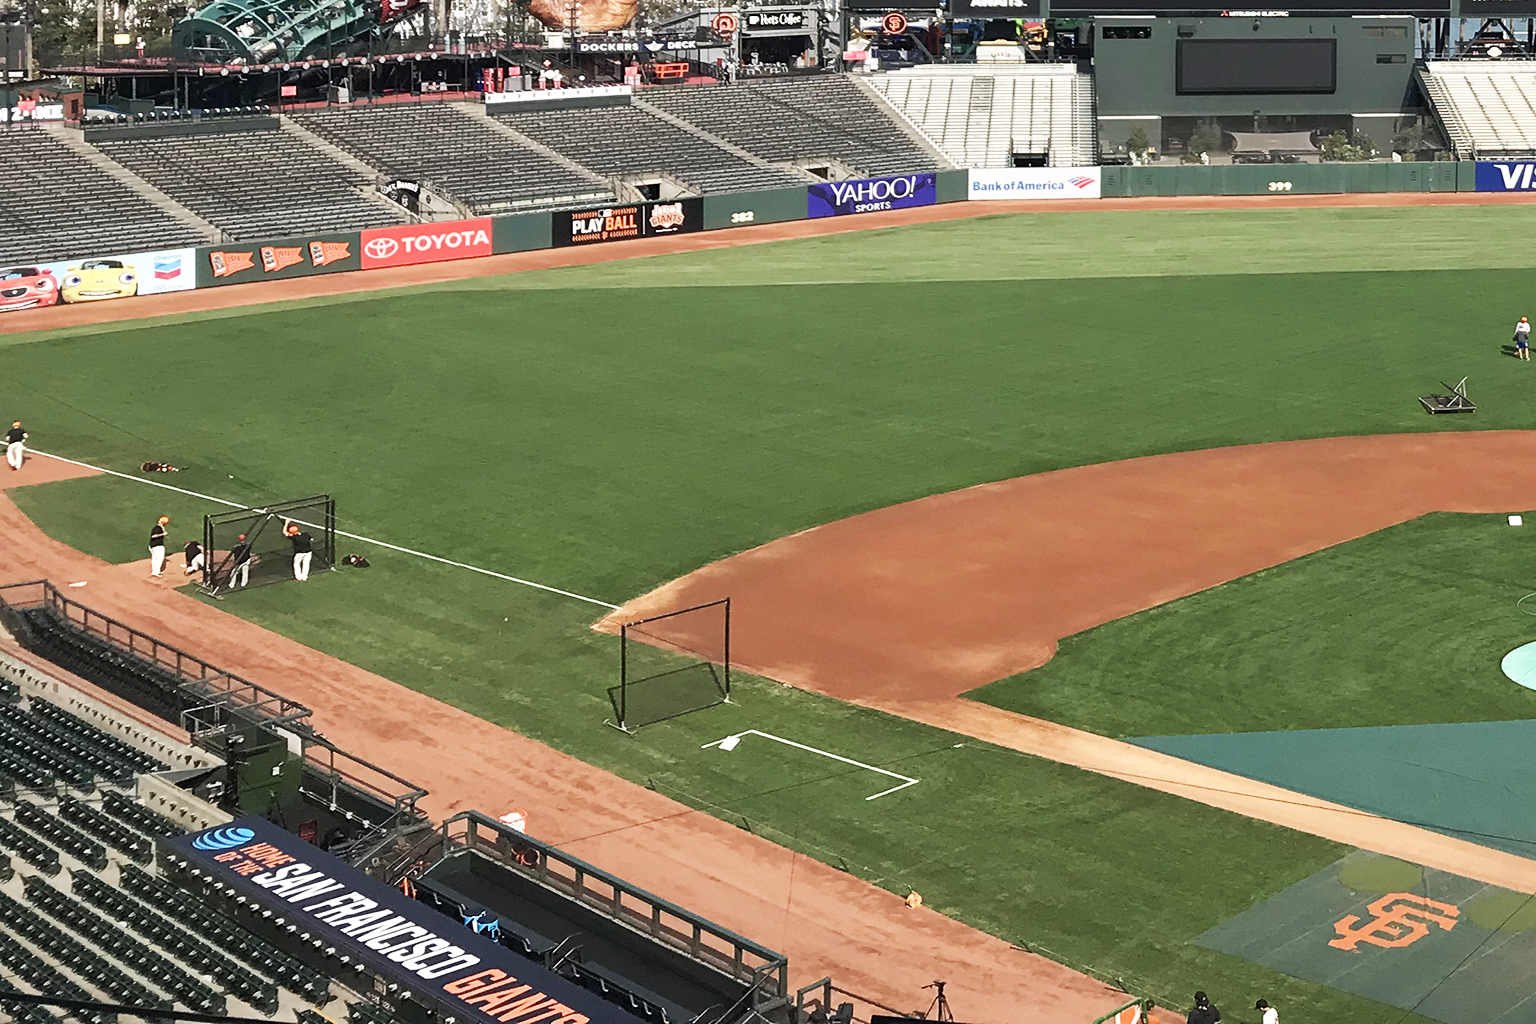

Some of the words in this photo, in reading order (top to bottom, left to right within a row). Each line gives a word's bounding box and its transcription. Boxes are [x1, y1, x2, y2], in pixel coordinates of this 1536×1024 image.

[781, 13, 802, 25] Coffee
[580, 42, 639, 52] DOCKERS
[667, 40, 697, 50] DECK
[830, 175, 917, 206] YAHOO!
[972, 181, 1002, 191] Bank
[1003, 180, 1015, 190] of
[1017, 179, 1065, 190] America
[1268, 180, 1292, 191] 399
[855, 200, 892, 213] SPORTS
[650, 213, 684, 225] GIANTS
[731, 211, 754, 223] 382
[572, 218, 604, 235] PLAY
[605, 214, 638, 231] BALL
[401, 229, 490, 253] TOYOTA
[239, 842, 297, 869] HOME
[213, 851, 243, 863] OF
[229, 859, 264, 876] THE
[251, 863, 346, 904] SAN
[313, 892, 482, 980] FRANCISCO
